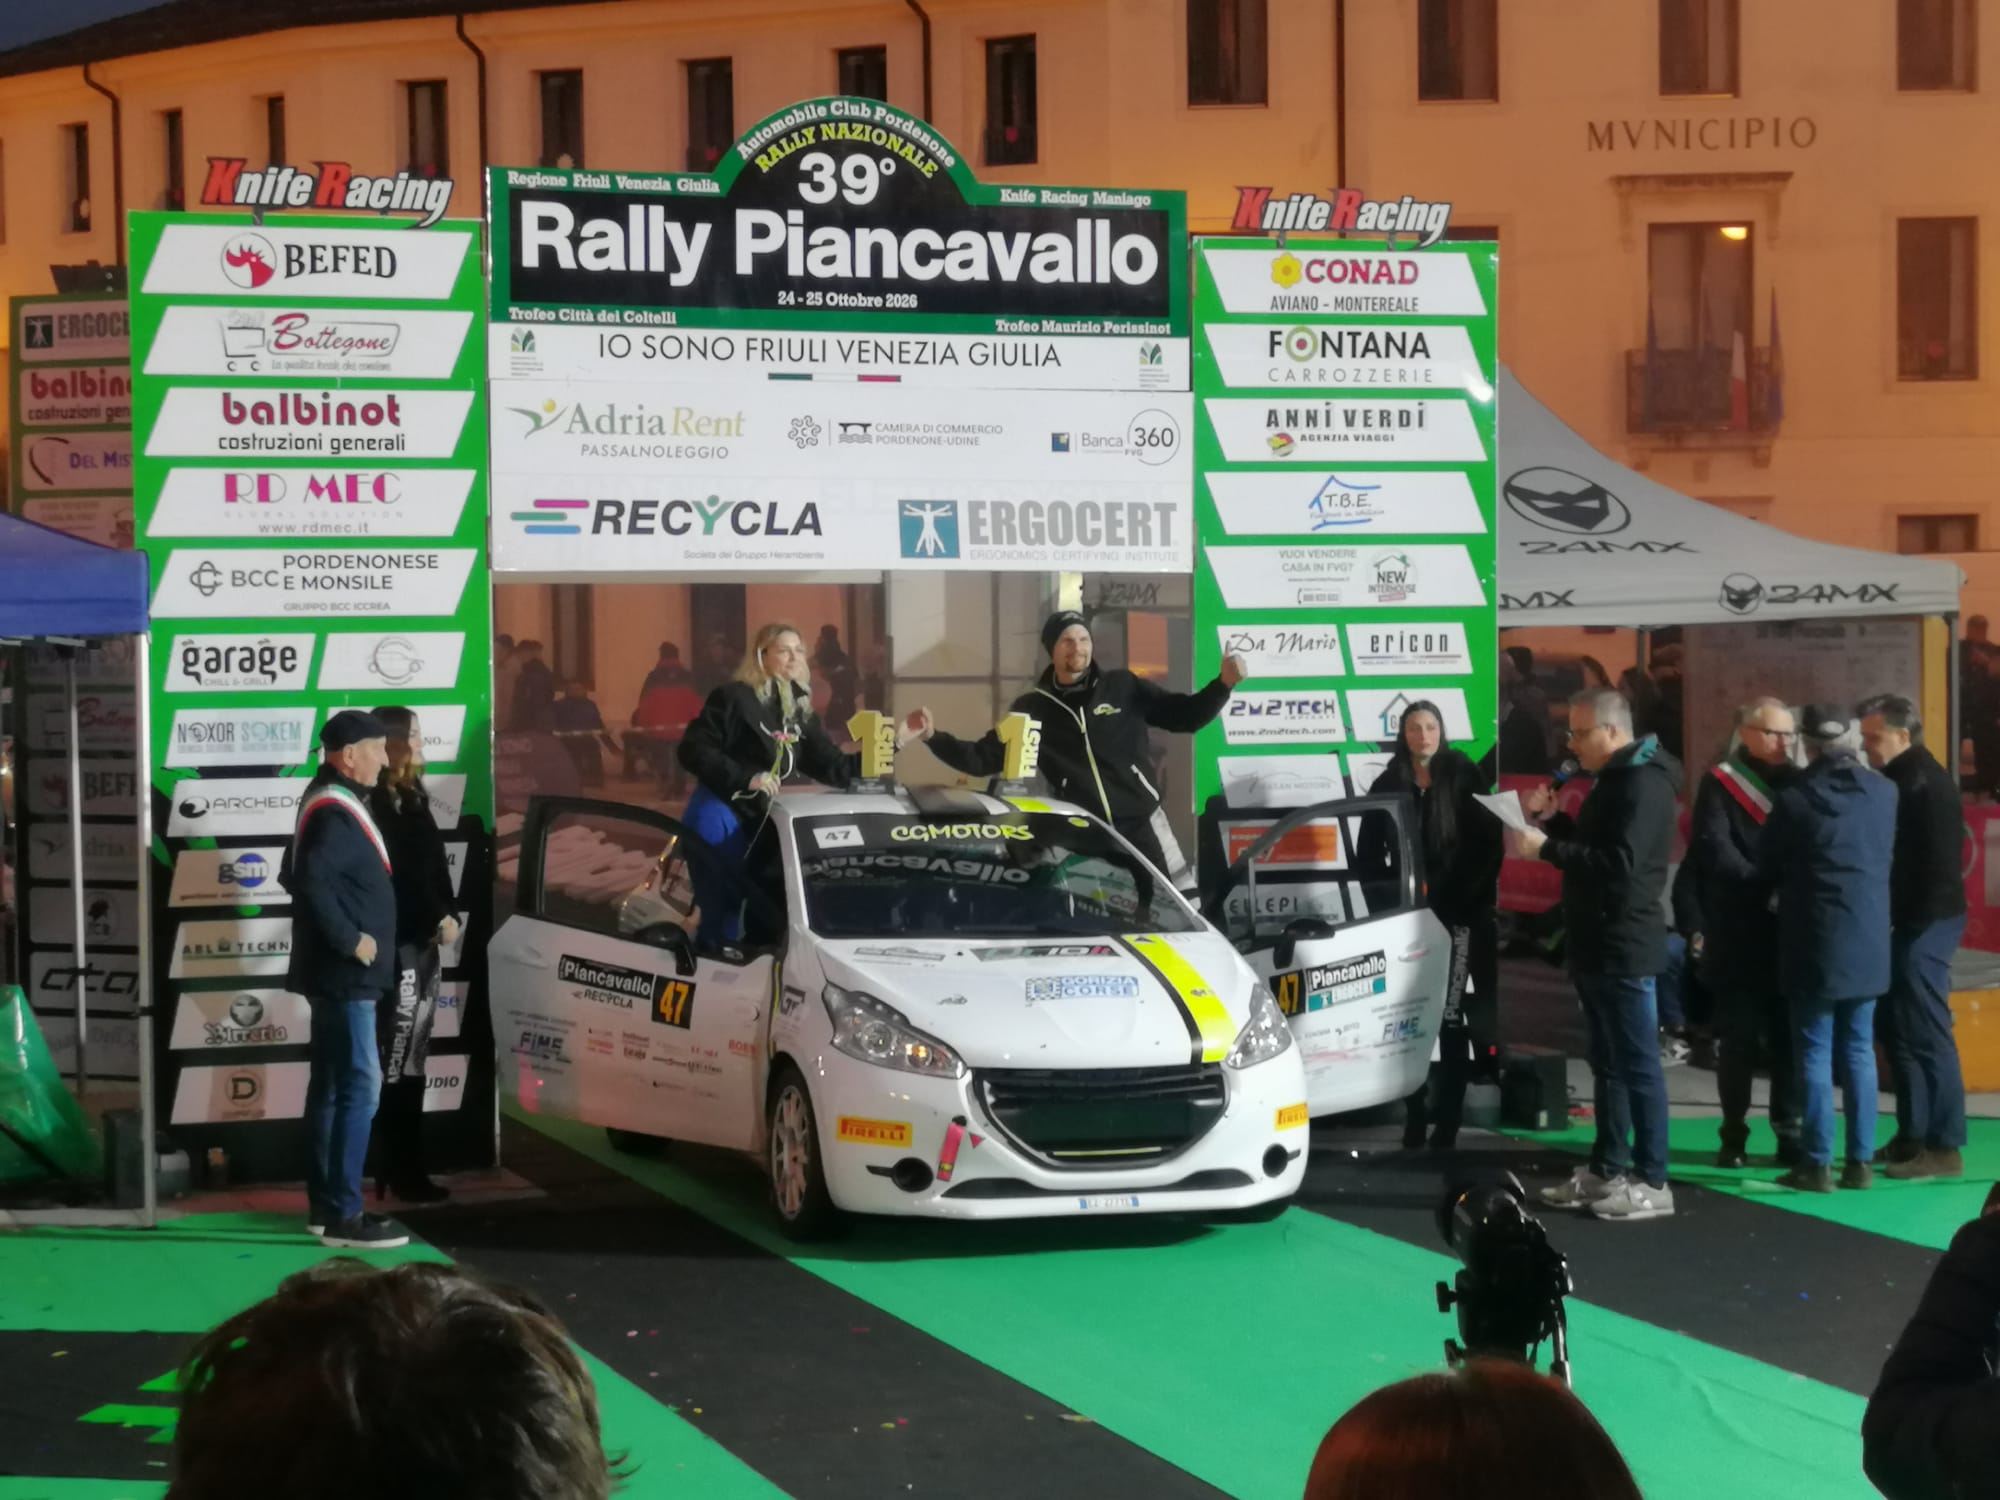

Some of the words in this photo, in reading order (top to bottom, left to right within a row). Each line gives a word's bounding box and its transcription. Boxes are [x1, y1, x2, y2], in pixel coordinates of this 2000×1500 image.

[737, 102, 828, 160] Automobile
[830, 100, 871, 118] Club
[874, 101, 956, 168] Pordenone
[1587, 117, 1818, 152] MVNICIPIO
[755, 126, 817, 173] RALLY
[819, 121, 938, 179] NAZIONALE
[201, 156, 314, 206] Knife
[311, 160, 454, 230] Racing
[507, 171, 567, 188] Regione
[573, 172, 611, 189] Friuli
[616, 174, 672, 192] Venezia
[676, 176, 720, 194] Giulia
[1000, 188, 1036, 204] Knife
[1040, 189, 1088, 208] Racing
[1092, 190, 1151, 208] Maniago
[1232, 186, 1331, 230] Knife
[1328, 187, 1452, 250] Racing
[520, 199, 713, 287] Rally
[735, 207, 1159, 286] Piancavallo
[283, 243, 397, 279] BEFED
[1305, 259, 1419, 286] CONAD
[777, 291, 795, 305] 24
[806, 291, 824, 306] 25
[825, 290, 884, 308] Ottobre
[885, 293, 918, 308] 2026
[1270, 296, 1319, 312] AVIANO
[1334, 296, 1419, 312] MONTEREALE
[508, 307, 556, 322] Trofeo
[558, 307, 594, 322] Città
[596, 309, 620, 323] dei
[623, 309, 677, 325] Coltelli
[995, 319, 1039, 333] Trofeo
[1041, 320, 1101, 335] Maurizio
[1103, 321, 1172, 335] Perissinot
[271, 312, 390, 356] Bottegone
[1268, 326, 1432, 363] FONTANA
[600, 334, 632, 358] IO
[642, 335, 736, 362] SONO
[746, 337, 827, 363] FRIULI
[837, 339, 960, 365] VENEZIA
[968, 341, 1063, 367] GIULIA
[1268, 368, 1433, 383] CARROZZERIE
[221, 391, 401, 427] balbinot
[563, 402, 667, 435] Adria
[670, 405, 747, 437] Rent
[875, 422, 920, 434] CAMERA
[923, 423, 934, 434] DI
[936, 424, 1003, 435] COMMERCIO
[1081, 433, 1123, 448] Banca
[1133, 428, 1175, 449] 360
[1300, 434, 1350, 442] AGENZIA
[1353, 434, 1395, 442] VIAGGI
[218, 432, 323, 451] costruzioni
[330, 433, 406, 455] generali
[580, 444, 730, 459] PASSALNOLEGGIO
[875, 435, 980, 446] PORDENONE-UDINE
[224, 472, 288, 505] RD
[303, 471, 403, 505] MEC
[591, 495, 823, 537] RECYCLA
[966, 500, 1178, 547] ERGOCERT
[258, 521, 369, 535] www.rdmec.it
[282, 555, 439, 570] PORDENONESE
[969, 550, 1048, 562] ERGONOMICS
[1053, 550, 1119, 562] CERTIFYING
[1125, 551, 1179, 562] INSTITUTE
[1279, 549, 1306, 559] VUOI
[1308, 549, 1357, 559] VENDERE
[230, 570, 280, 588] BCC
[283, 576, 296, 591] E
[301, 575, 393, 591] MONSILE
[1367, 584, 1417, 595] INTERHOUSE
[1376, 571, 1408, 585] NEW
[1499, 588, 1577, 610] MX
[1765, 583, 1900, 605] 24MX
[283, 602, 328, 612] GRUPPO
[330, 602, 351, 612] BCC
[353, 602, 391, 612] ICCREA
[1227, 630, 1265, 652] Da
[1274, 630, 1337, 653] Mario
[1370, 631, 1449, 654] ericon
[181, 644, 298, 686] garage
[177, 723, 235, 744] NOXOR
[563, 960, 652, 996] Piancavallo
[1061, 975, 1137, 987] GORIZIA
[1311, 955, 1387, 990] Piancavallo
[397, 968, 417, 1017] Rally
[583, 988, 634, 1010] RECYCLA
[658, 980, 690, 1025] 47
[1061, 986, 1135, 998] CORSE
[1276, 972, 1300, 1015] 47
[840, 1118, 906, 1141] PIRELLI
